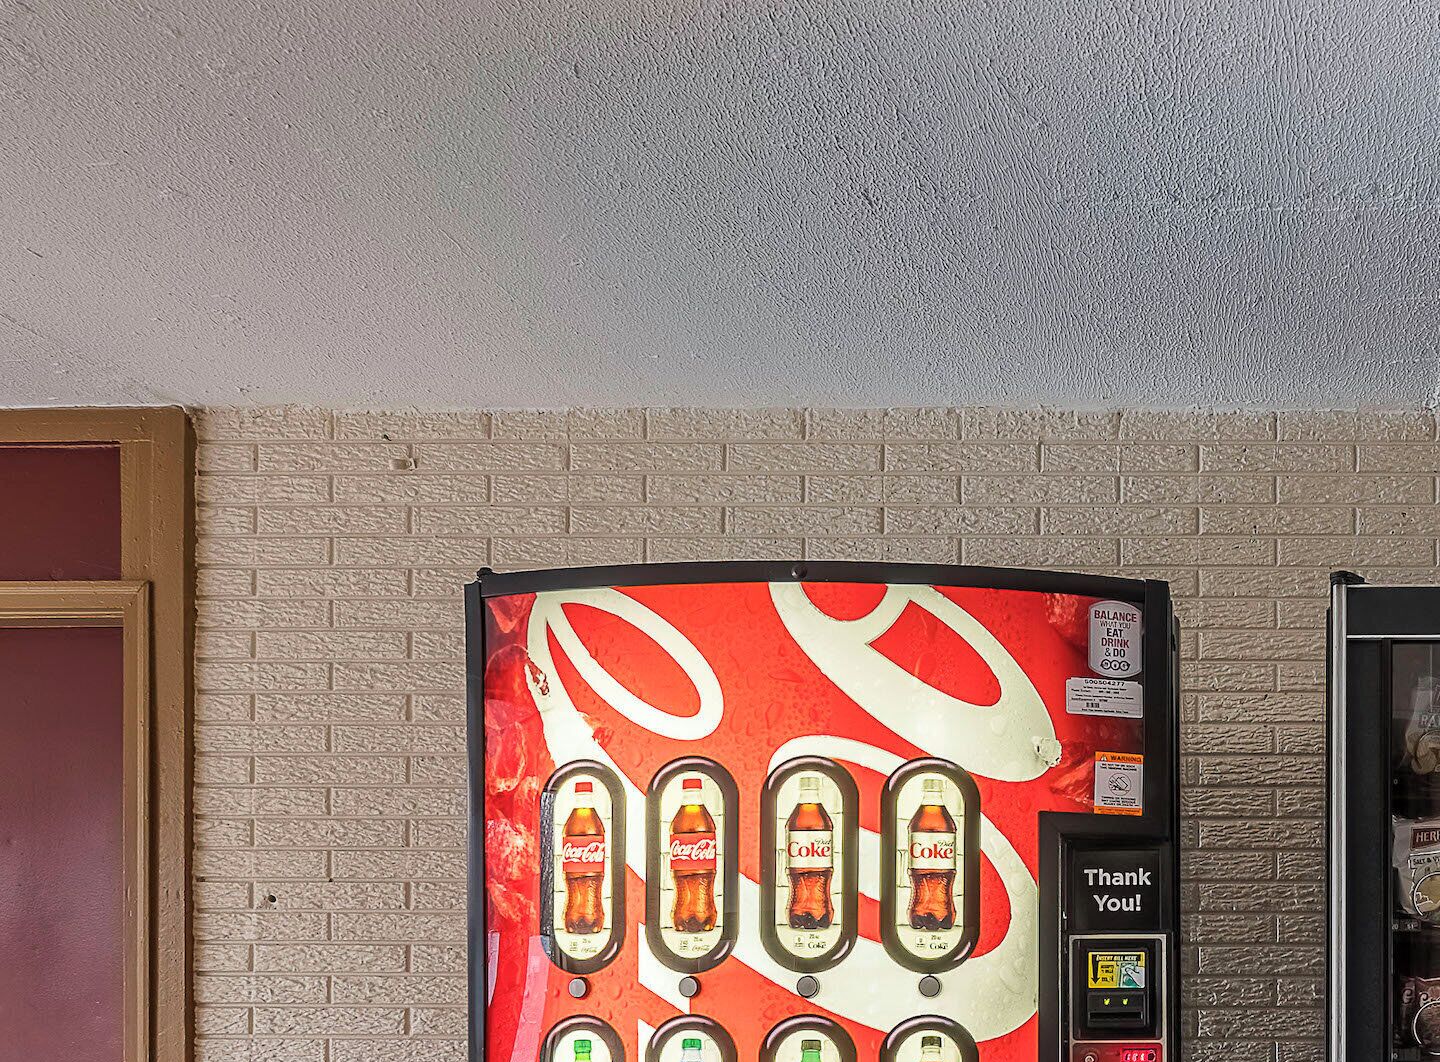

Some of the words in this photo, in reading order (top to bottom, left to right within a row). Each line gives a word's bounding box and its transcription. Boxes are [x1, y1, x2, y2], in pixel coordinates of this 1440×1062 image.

[1094, 609, 1137, 623] BALANCE
[1100, 620, 1116, 629] WHAT
[1117, 621, 1131, 629] YOU
[1106, 628, 1123, 638] EAT
[1101, 637, 1129, 649] DRINK
[1105, 648, 1112, 657] &
[1113, 648, 1126, 658] DO
[563, 842, 606, 863] Coca-Cola
[670, 840, 716, 861] Coca-Cola
[787, 841, 831, 857] Coke
[910, 842, 954, 859] Coke
[1412, 857, 1426, 866] SALT
[1083, 868, 1152, 886] Thank
[1093, 894, 1142, 912] You!
